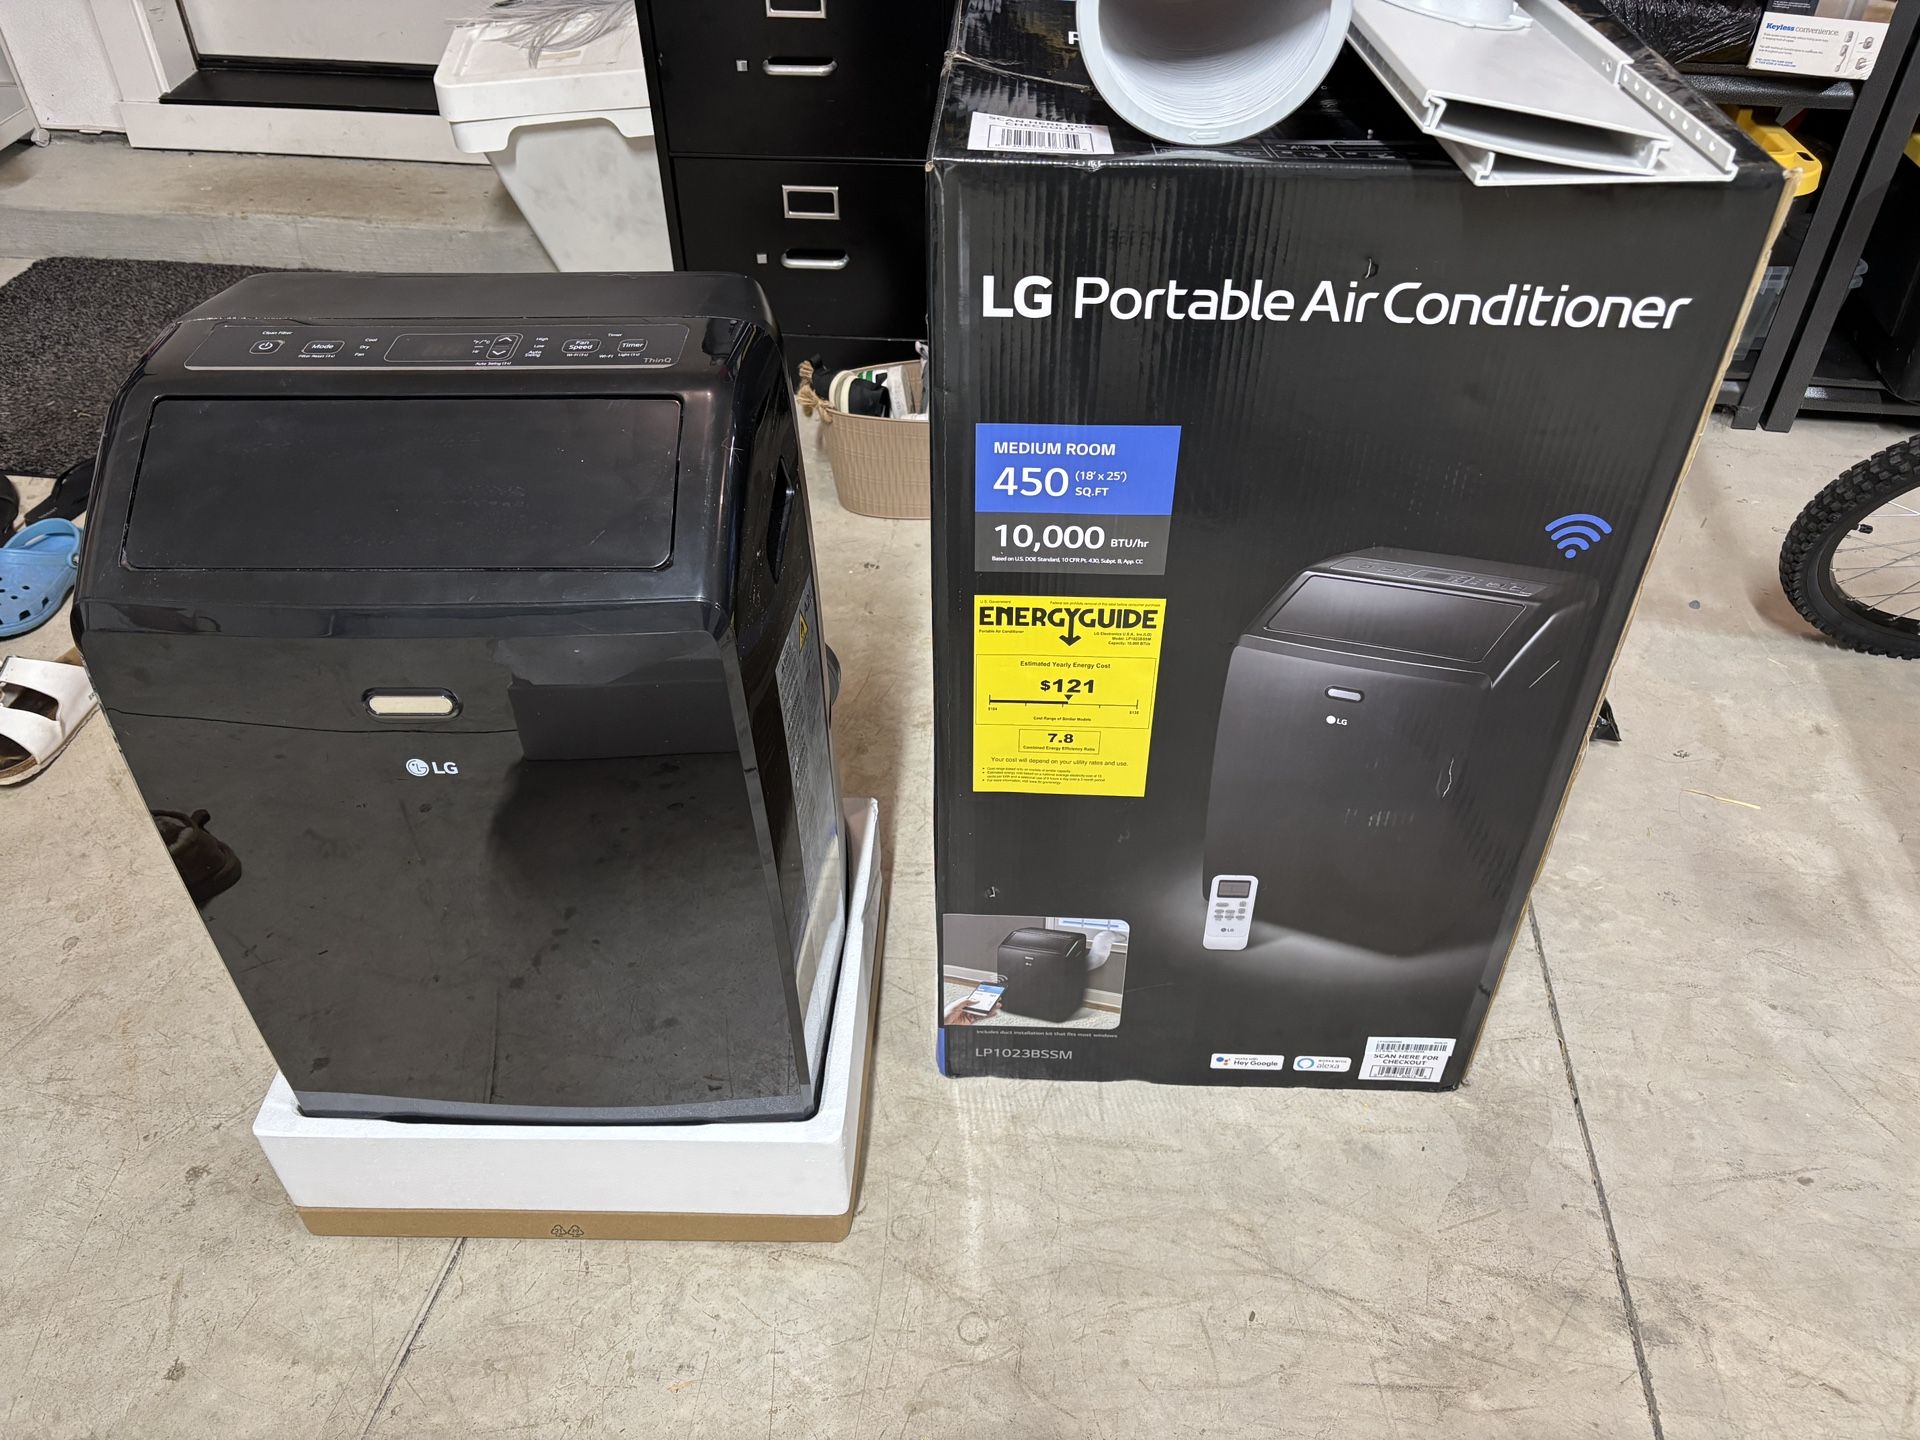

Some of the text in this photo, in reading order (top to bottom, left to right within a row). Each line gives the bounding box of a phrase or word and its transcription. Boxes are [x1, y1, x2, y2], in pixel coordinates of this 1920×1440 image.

[1766, 22, 1795, 32] Keyless
[989, 116, 1024, 124] SCAN
[1005, 121, 1075, 131] CHECKOUT
[981, 275, 1692, 330] LG Portable Air Conditioner
[994, 441, 1116, 456] MEDIUM ROOM
[992, 467, 1069, 497] 450
[1098, 473, 1104, 481] x
[1075, 487, 1109, 497] SQ.FT
[994, 524, 1150, 553] 10,000 BTU/hr
[1052, 661, 1072, 669] Yearly
[1040, 678, 1095, 694] $121
[1336, 717, 1348, 726] LG
[1047, 733, 1074, 744] 7.8
[431, 761, 459, 775] LG
[975, 1048, 1073, 1060] LP1023BSSM
